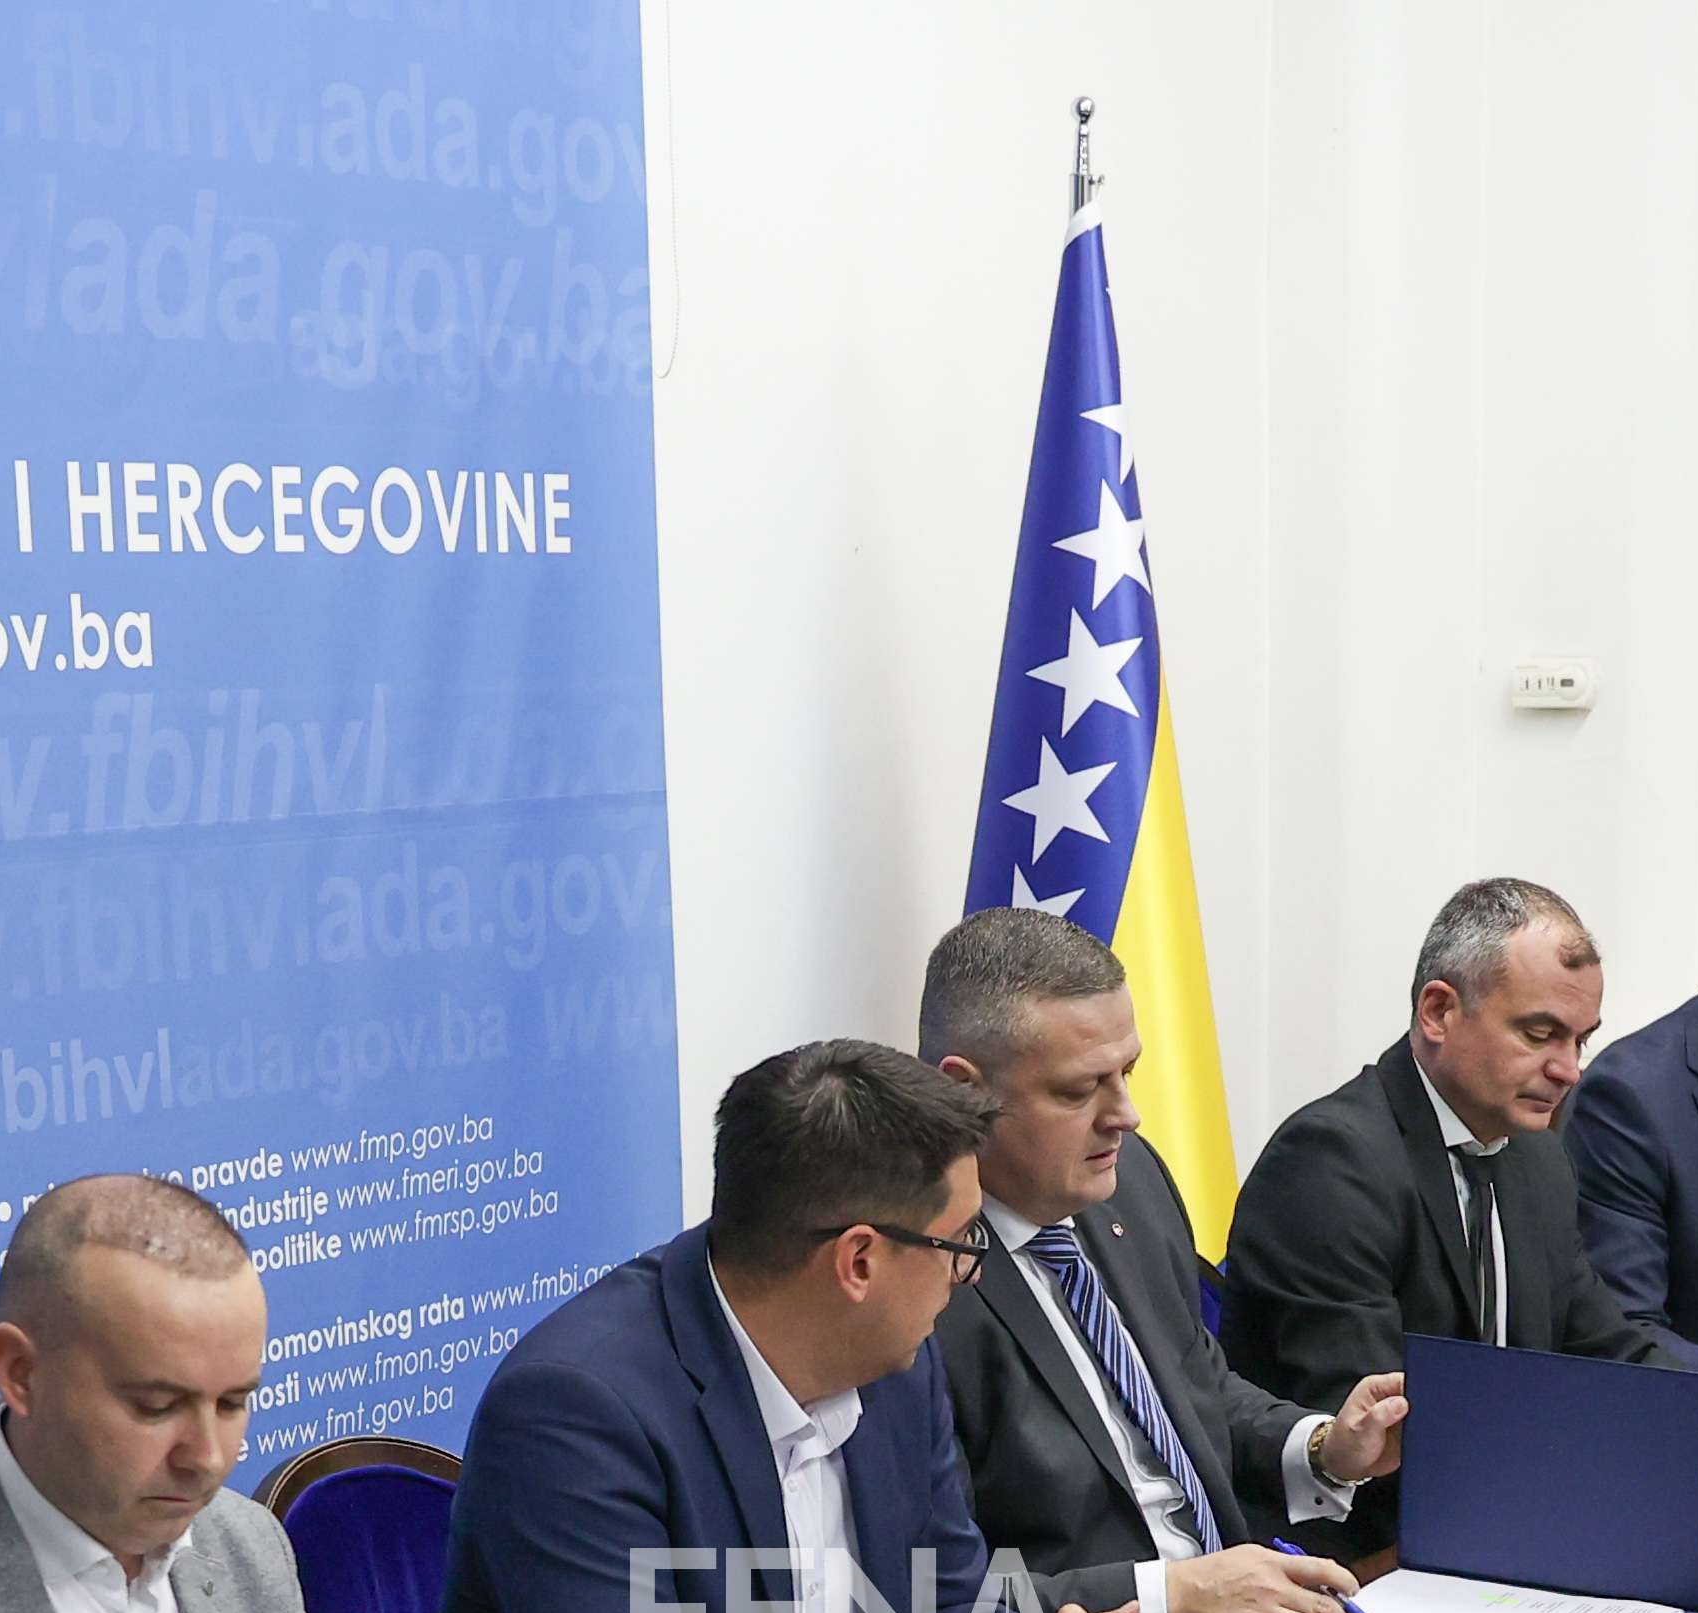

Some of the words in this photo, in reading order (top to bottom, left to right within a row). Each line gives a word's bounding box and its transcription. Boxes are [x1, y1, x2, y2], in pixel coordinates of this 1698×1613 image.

[15, 459, 35, 554] I
[65, 459, 573, 554] HERCEGOVINE
[192, 1147, 284, 1192] pravde
[290, 1112, 494, 1174] www.fmp.gov.ba
[335, 1147, 544, 1211] www.fmeri.gov.ba
[252, 1231, 343, 1274] politike
[348, 1188, 559, 1254] www.fmrsp.gov.ba
[420, 1296, 465, 1329] rata
[307, 1324, 519, 1398] www.fmon.gov.ba
[256, 1384, 454, 1456] www.fmt.gov.ba
